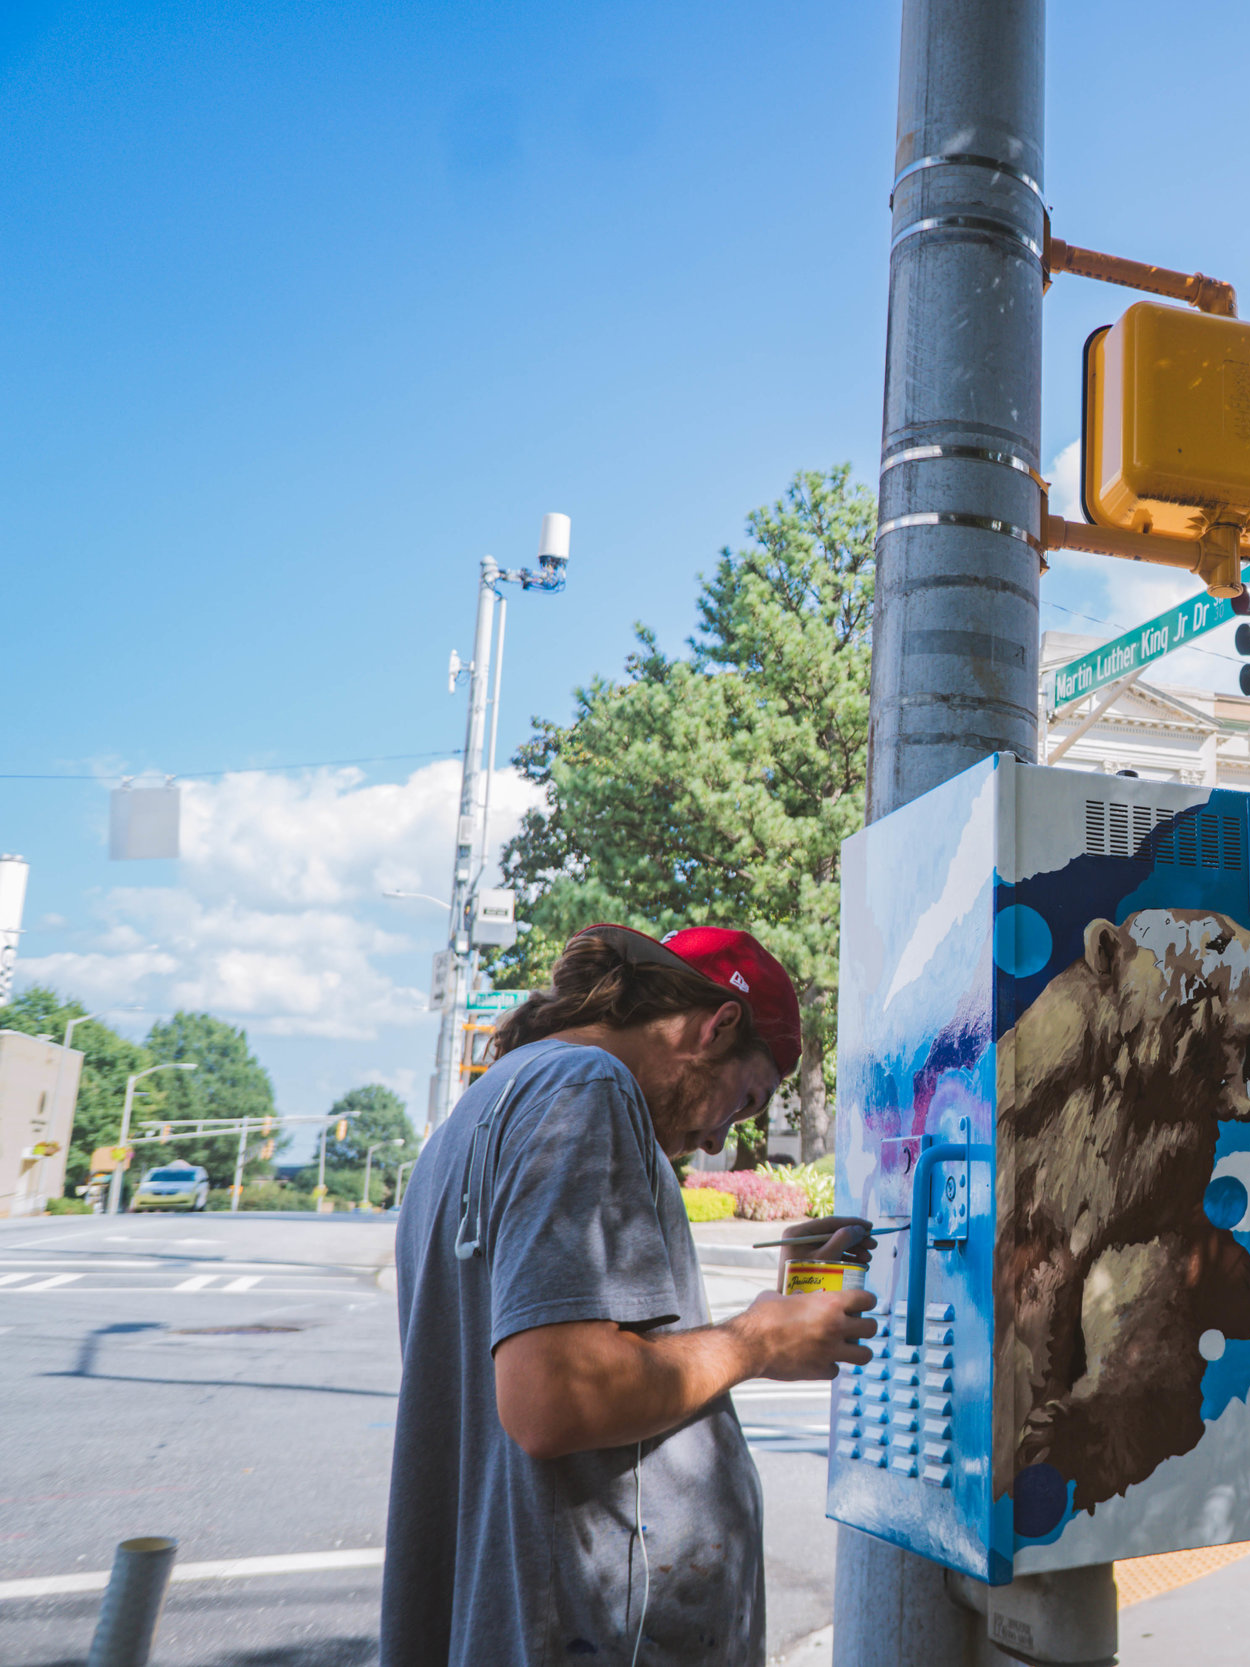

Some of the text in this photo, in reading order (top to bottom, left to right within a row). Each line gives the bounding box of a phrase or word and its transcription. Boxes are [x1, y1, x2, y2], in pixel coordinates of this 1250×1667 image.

[1056, 602, 1210, 702] Martin Luther King Jr Dr
